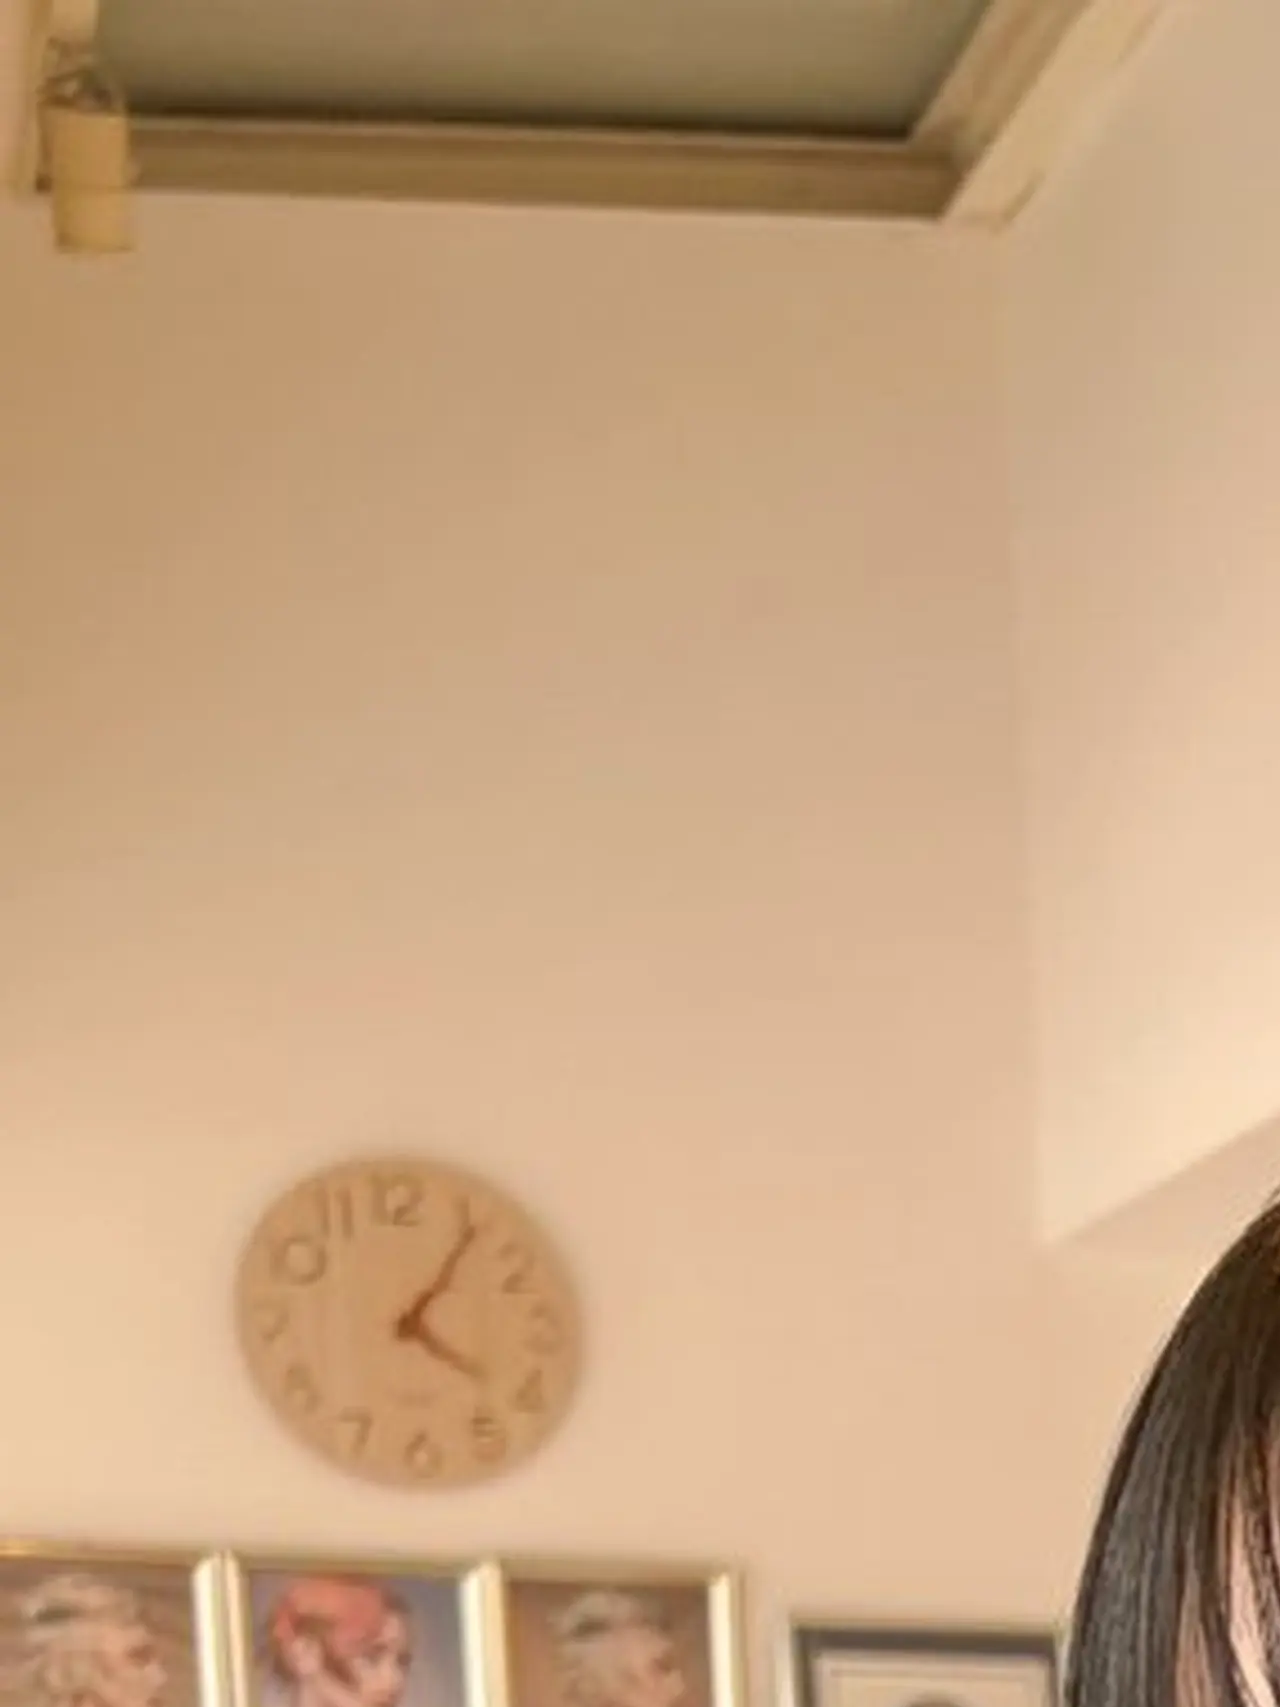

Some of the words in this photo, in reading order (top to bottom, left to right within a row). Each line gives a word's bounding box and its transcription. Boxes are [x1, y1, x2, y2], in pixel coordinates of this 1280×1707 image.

[316, 1184, 354, 1241] 11
[371, 1174, 425, 1228] 12
[497, 1242, 537, 1294] 2
[512, 1367, 548, 1414] 4
[339, 1404, 374, 1457] 7
[404, 1431, 444, 1480] 6
